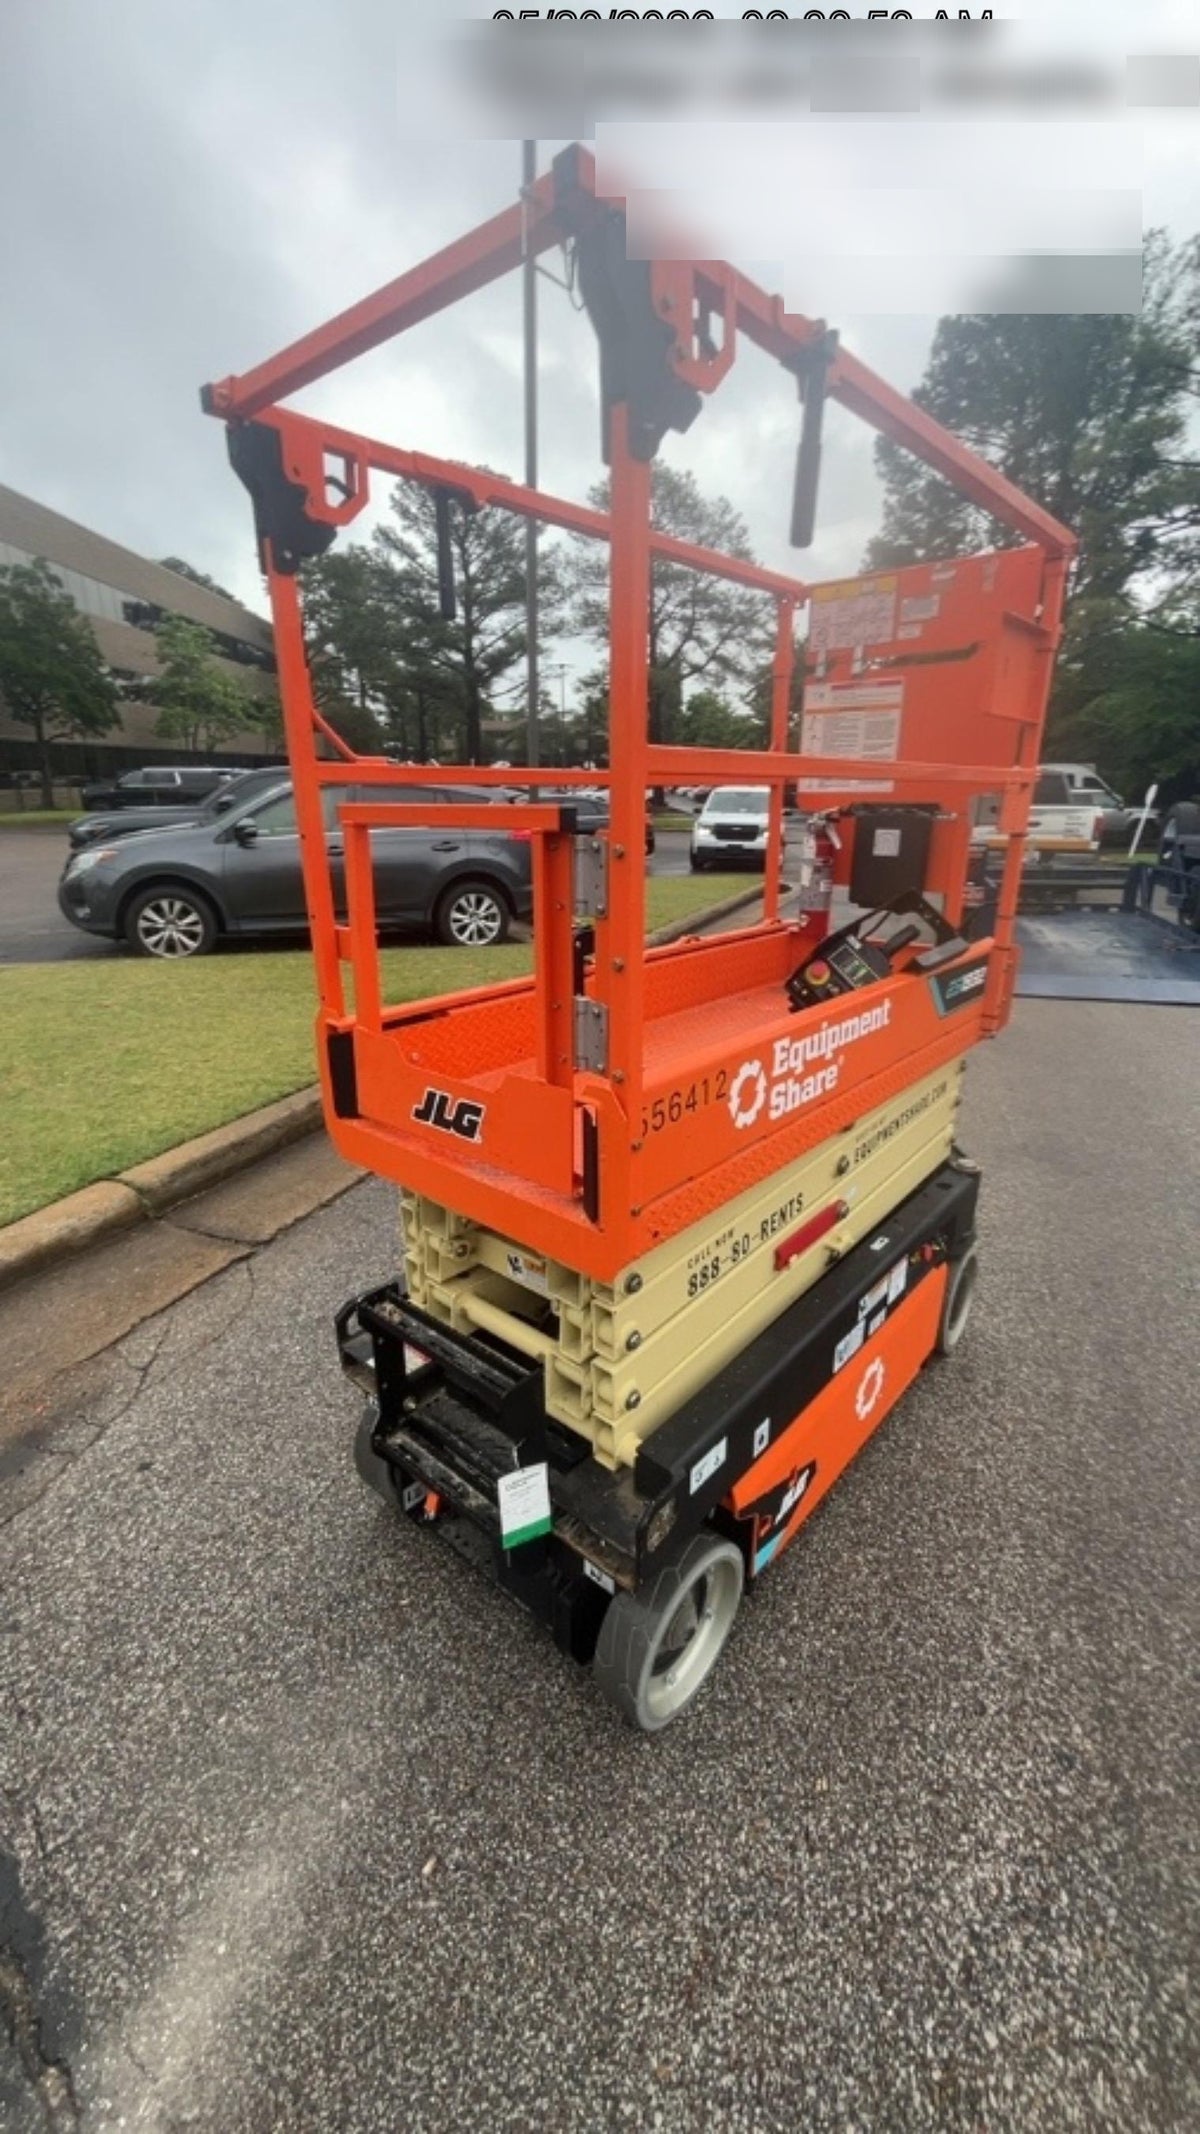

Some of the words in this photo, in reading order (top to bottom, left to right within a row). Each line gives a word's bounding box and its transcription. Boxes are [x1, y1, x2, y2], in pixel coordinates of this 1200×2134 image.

[771, 998, 891, 1077] Equipment
[411, 1087, 485, 1143] JLG
[768, 1063, 839, 1120] Share
